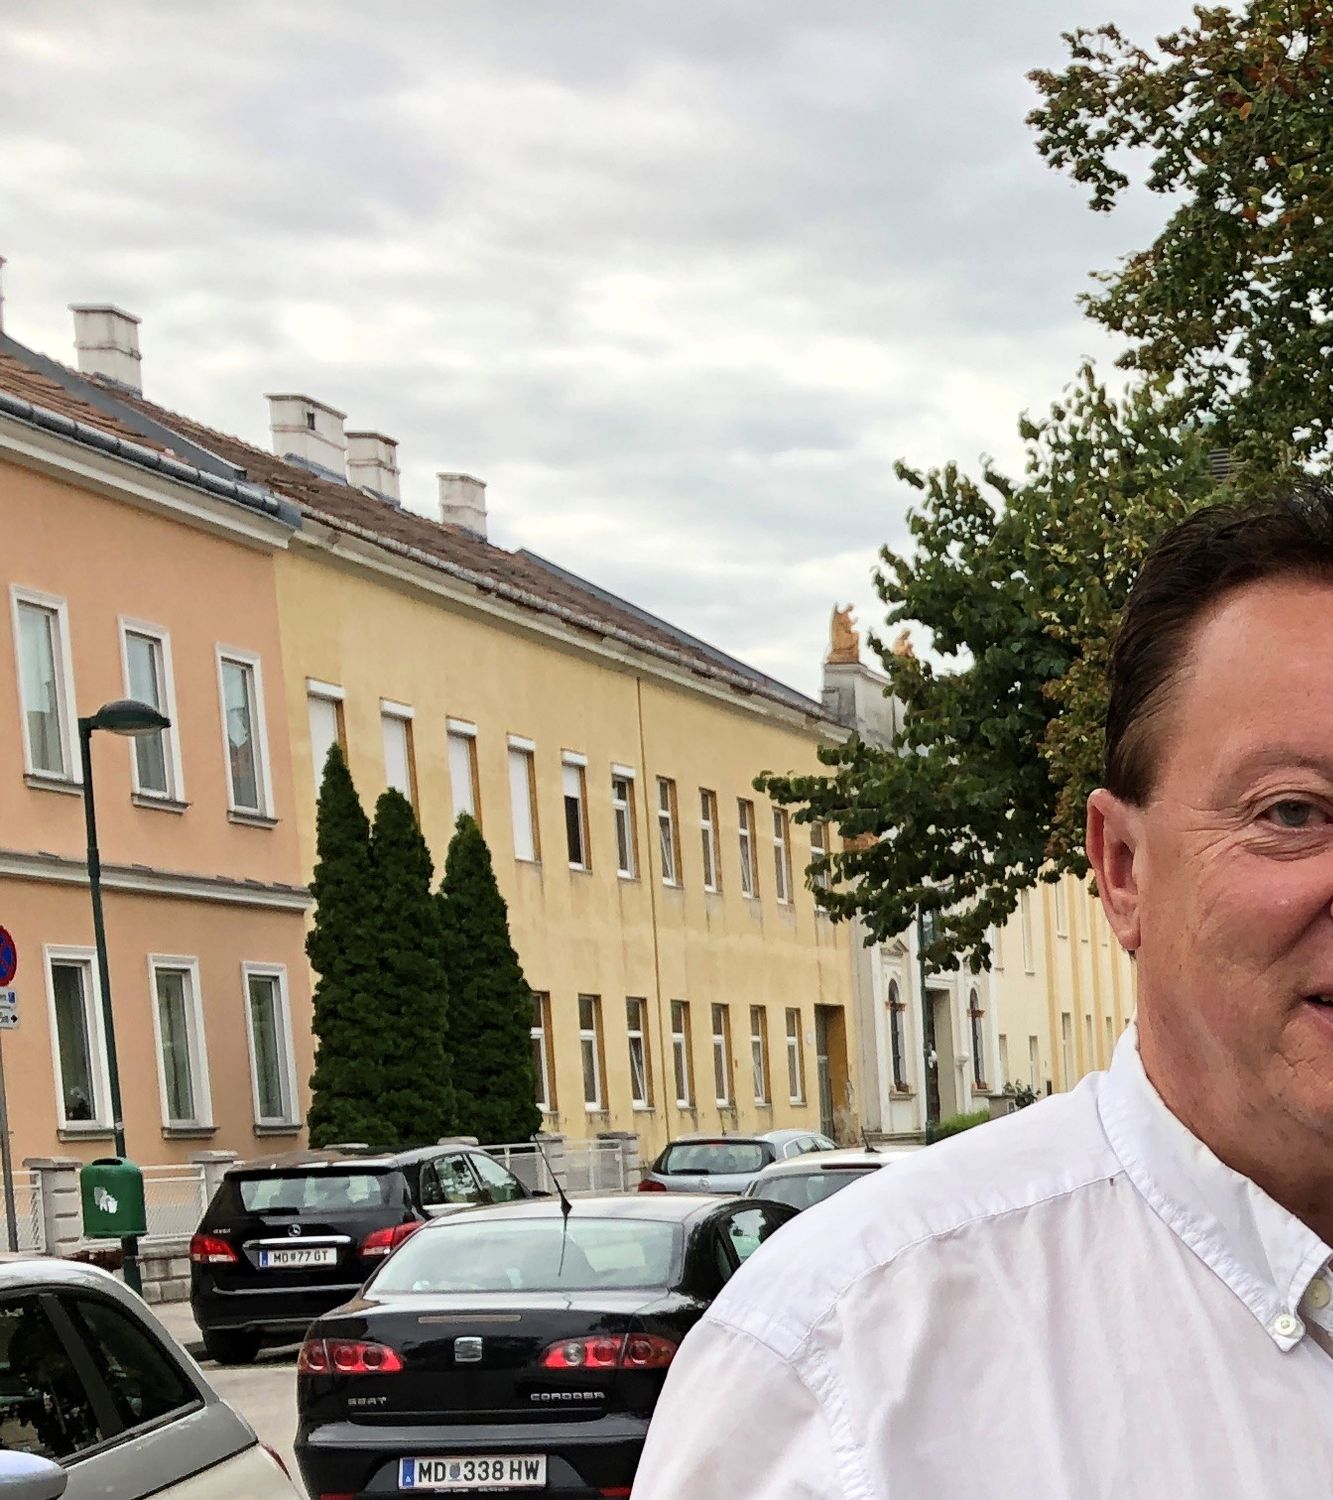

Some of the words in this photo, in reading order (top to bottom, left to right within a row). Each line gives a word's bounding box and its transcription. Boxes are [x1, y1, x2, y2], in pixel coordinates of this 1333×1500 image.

[273, 1250, 289, 1263] MD
[530, 1391, 605, 1401] CORDOBA
[418, 1461, 447, 1483] MD
[463, 1460, 504, 1481] 338
[509, 1459, 540, 1481] HW
